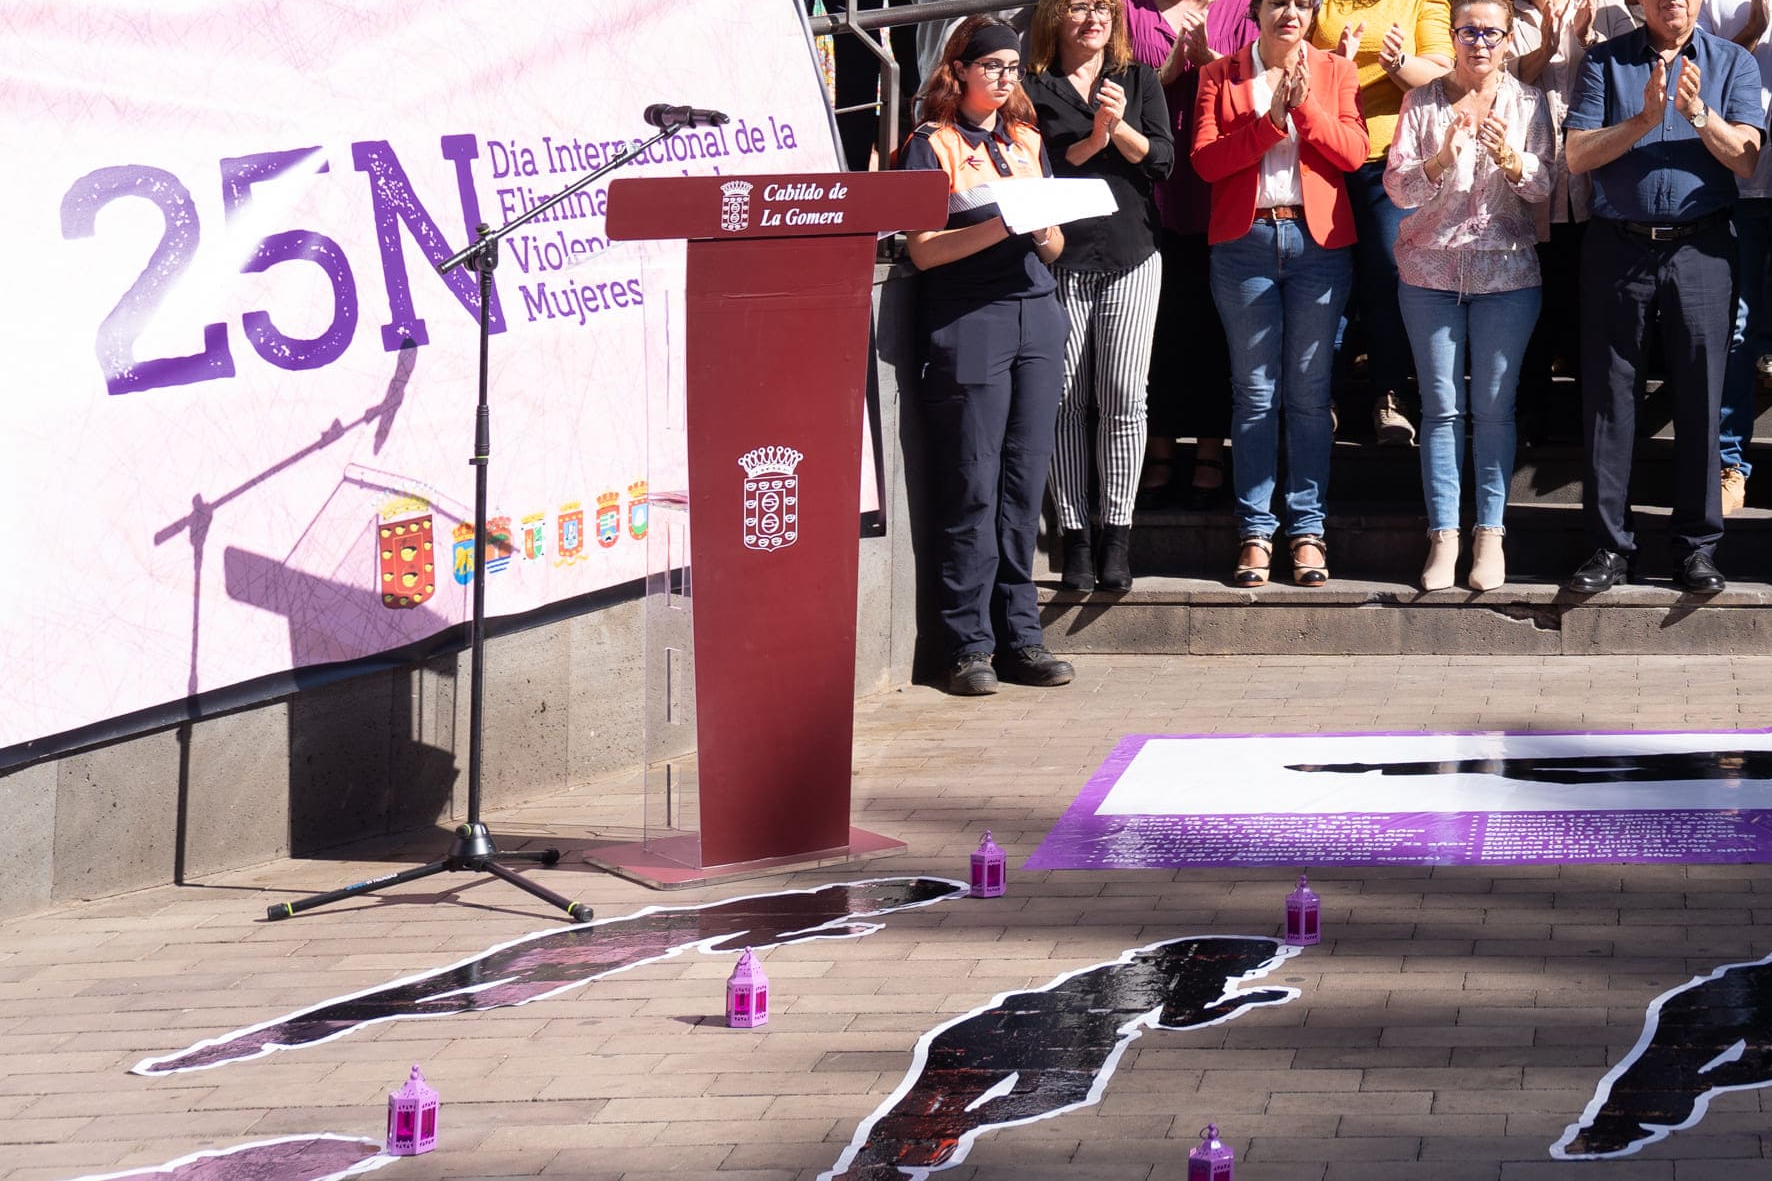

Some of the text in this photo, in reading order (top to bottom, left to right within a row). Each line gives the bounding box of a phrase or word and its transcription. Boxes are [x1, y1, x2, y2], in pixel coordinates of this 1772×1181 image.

[487, 139, 539, 179] Día
[734, 119, 766, 157] de
[768, 116, 797, 151] la
[496, 183, 607, 227] Elimina
[763, 182, 848, 202] Cabildo de
[760, 207, 844, 227] La Gomera
[60, 133, 508, 396] 25N
[518, 278, 644, 326] Mujeres
